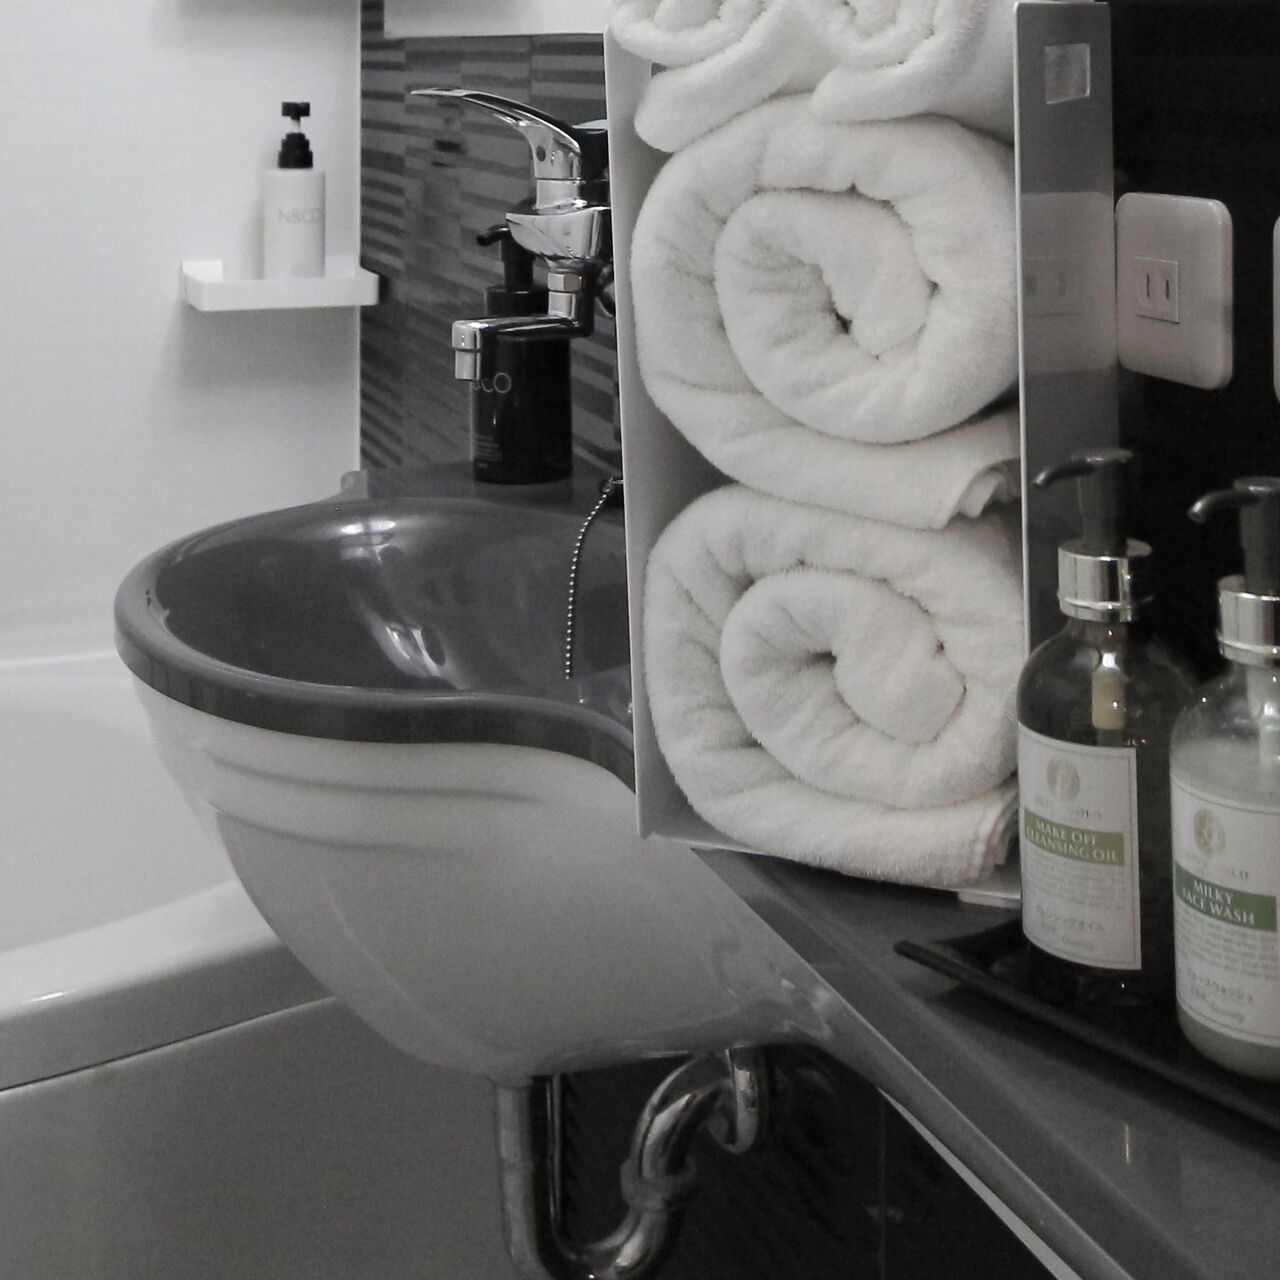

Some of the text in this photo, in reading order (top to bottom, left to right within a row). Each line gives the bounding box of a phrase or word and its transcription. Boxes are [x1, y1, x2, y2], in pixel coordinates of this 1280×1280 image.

[1025, 826, 1120, 862] CLEANSING OIL
[1035, 819, 1067, 839] MAKE
[1181, 887, 1256, 926] FACE WASH
[1193, 880, 1234, 905] MILKY
